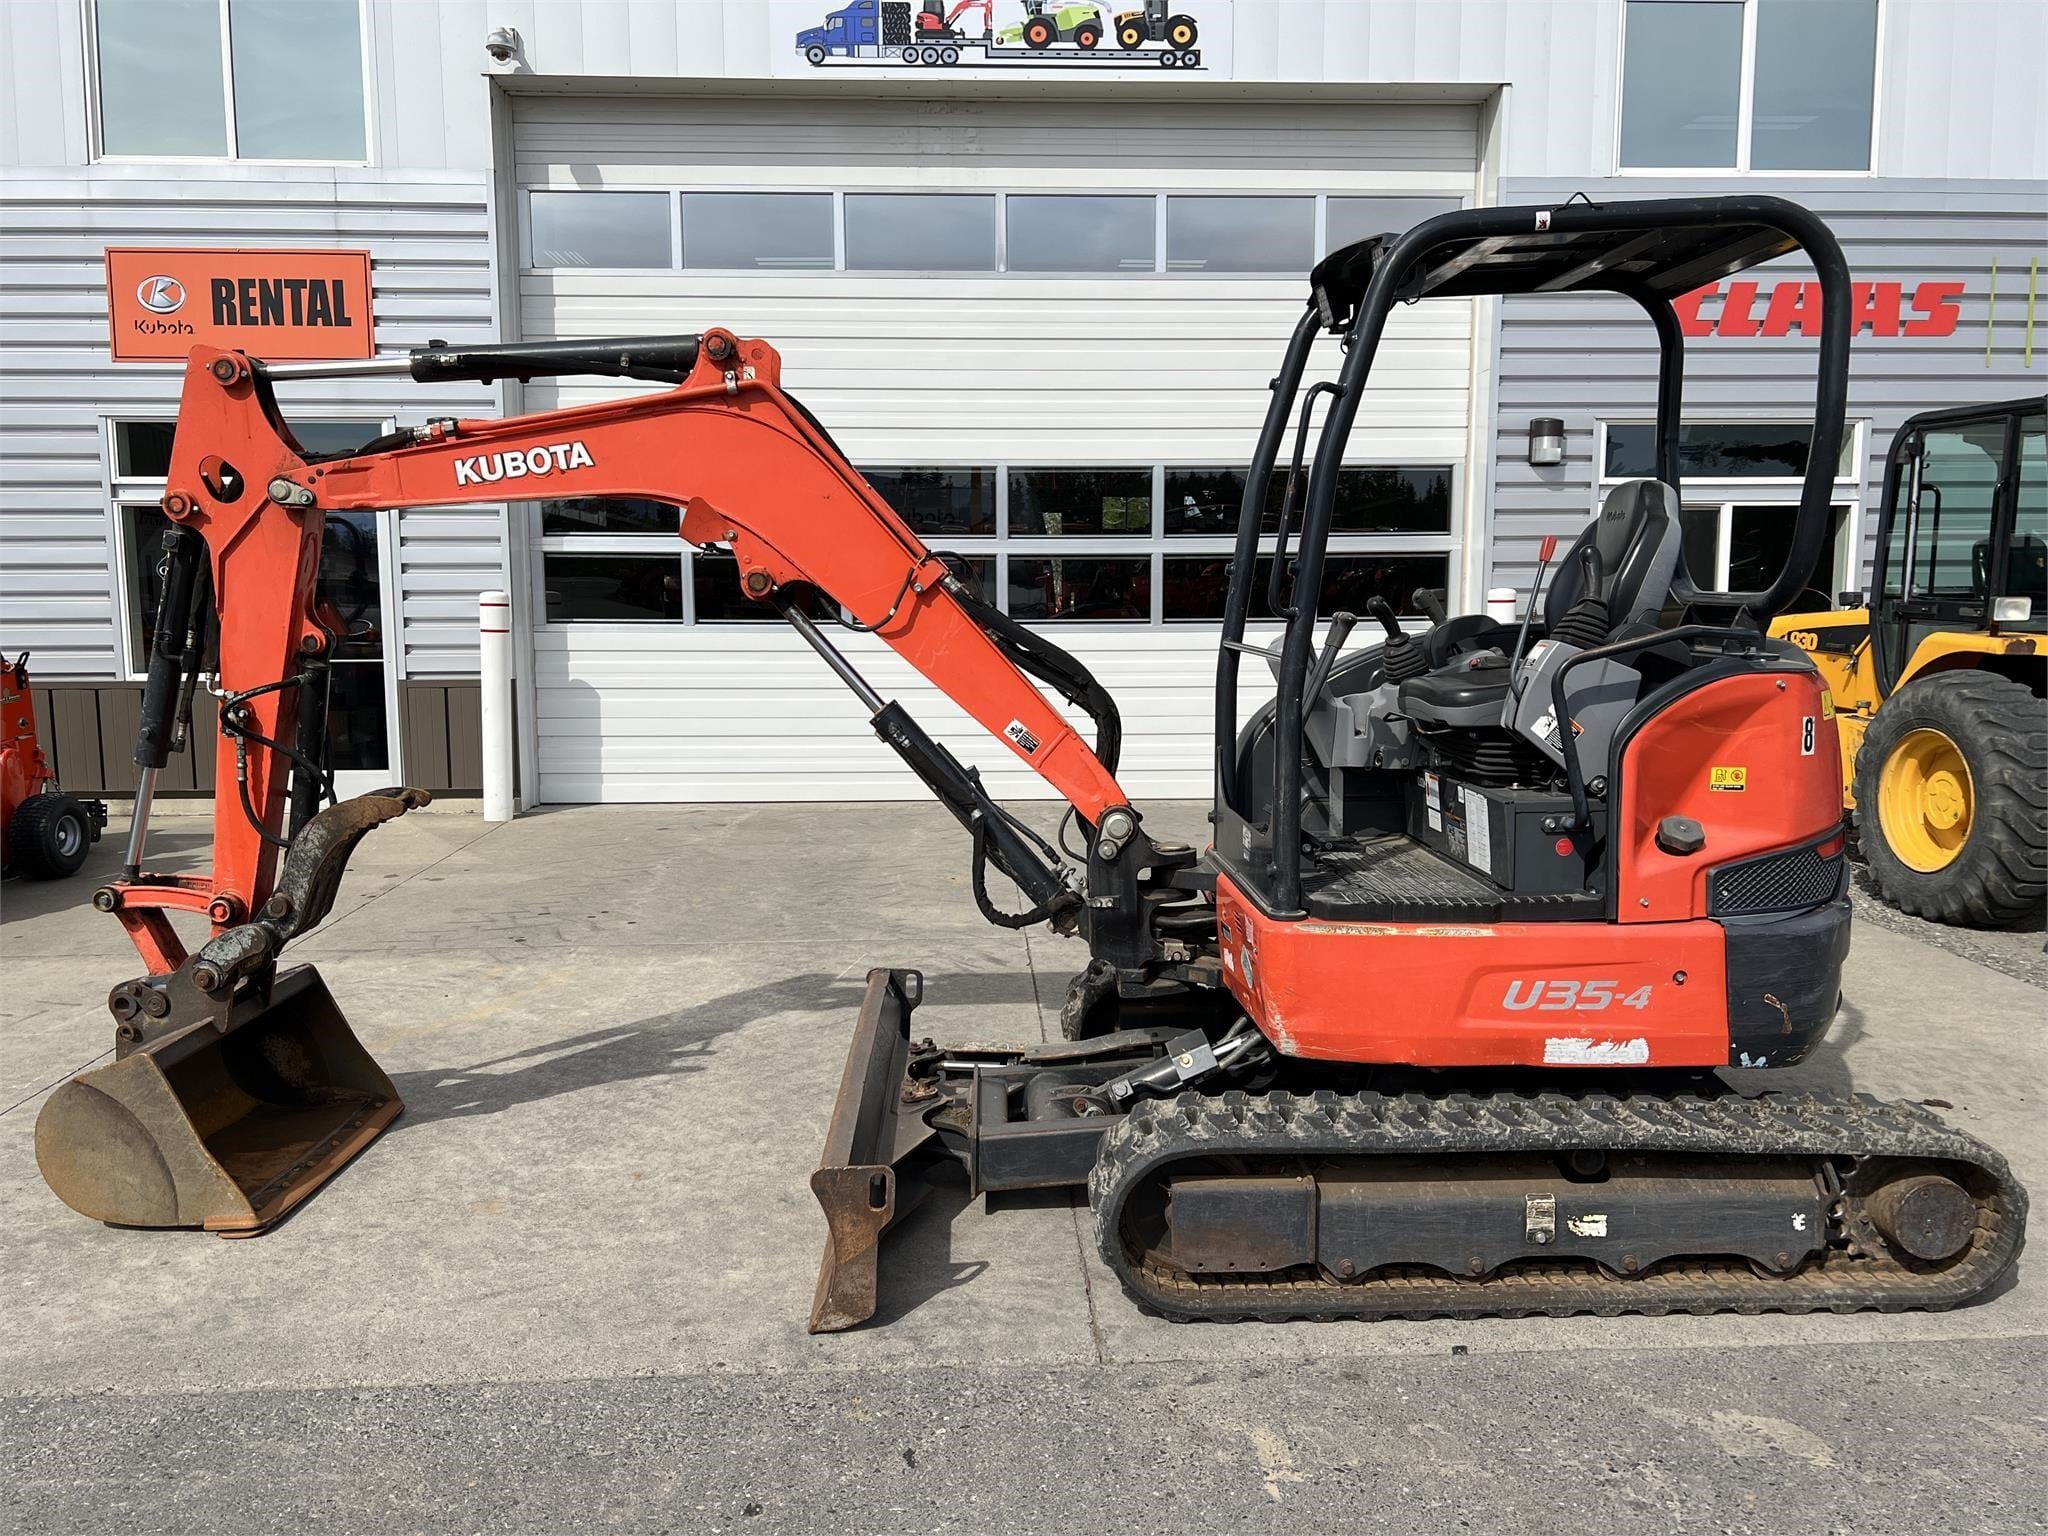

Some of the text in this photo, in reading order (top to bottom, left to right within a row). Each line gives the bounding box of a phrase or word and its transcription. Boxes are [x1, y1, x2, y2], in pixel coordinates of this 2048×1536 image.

[211, 278, 352, 327] RENTAL
[1671, 282, 1965, 337] CLAAS
[134, 319, 194, 335] Kubota
[453, 441, 595, 485] KUBOTA
[1803, 716, 1814, 752] 8
[1502, 980, 1653, 1011] U35-4
